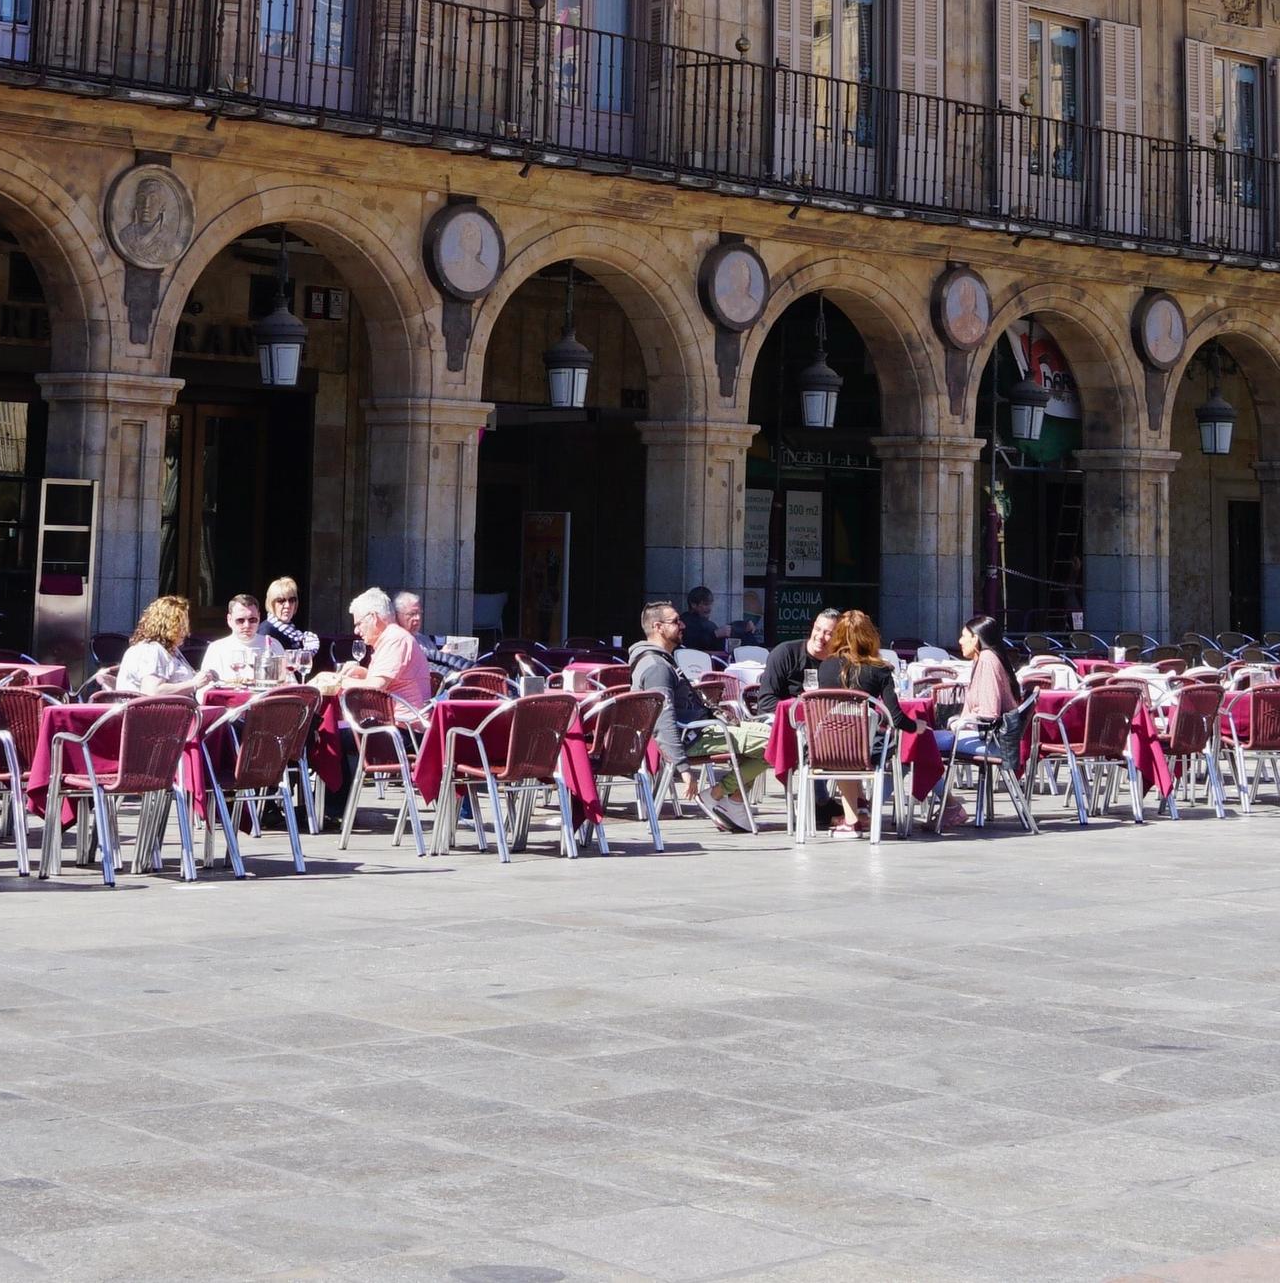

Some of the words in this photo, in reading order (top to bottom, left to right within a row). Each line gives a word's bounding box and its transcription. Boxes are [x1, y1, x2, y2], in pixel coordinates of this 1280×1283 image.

[787, 504, 804, 516] 300
[780, 591, 823, 606] ALQUILA
[778, 607, 811, 621] LOCAL
